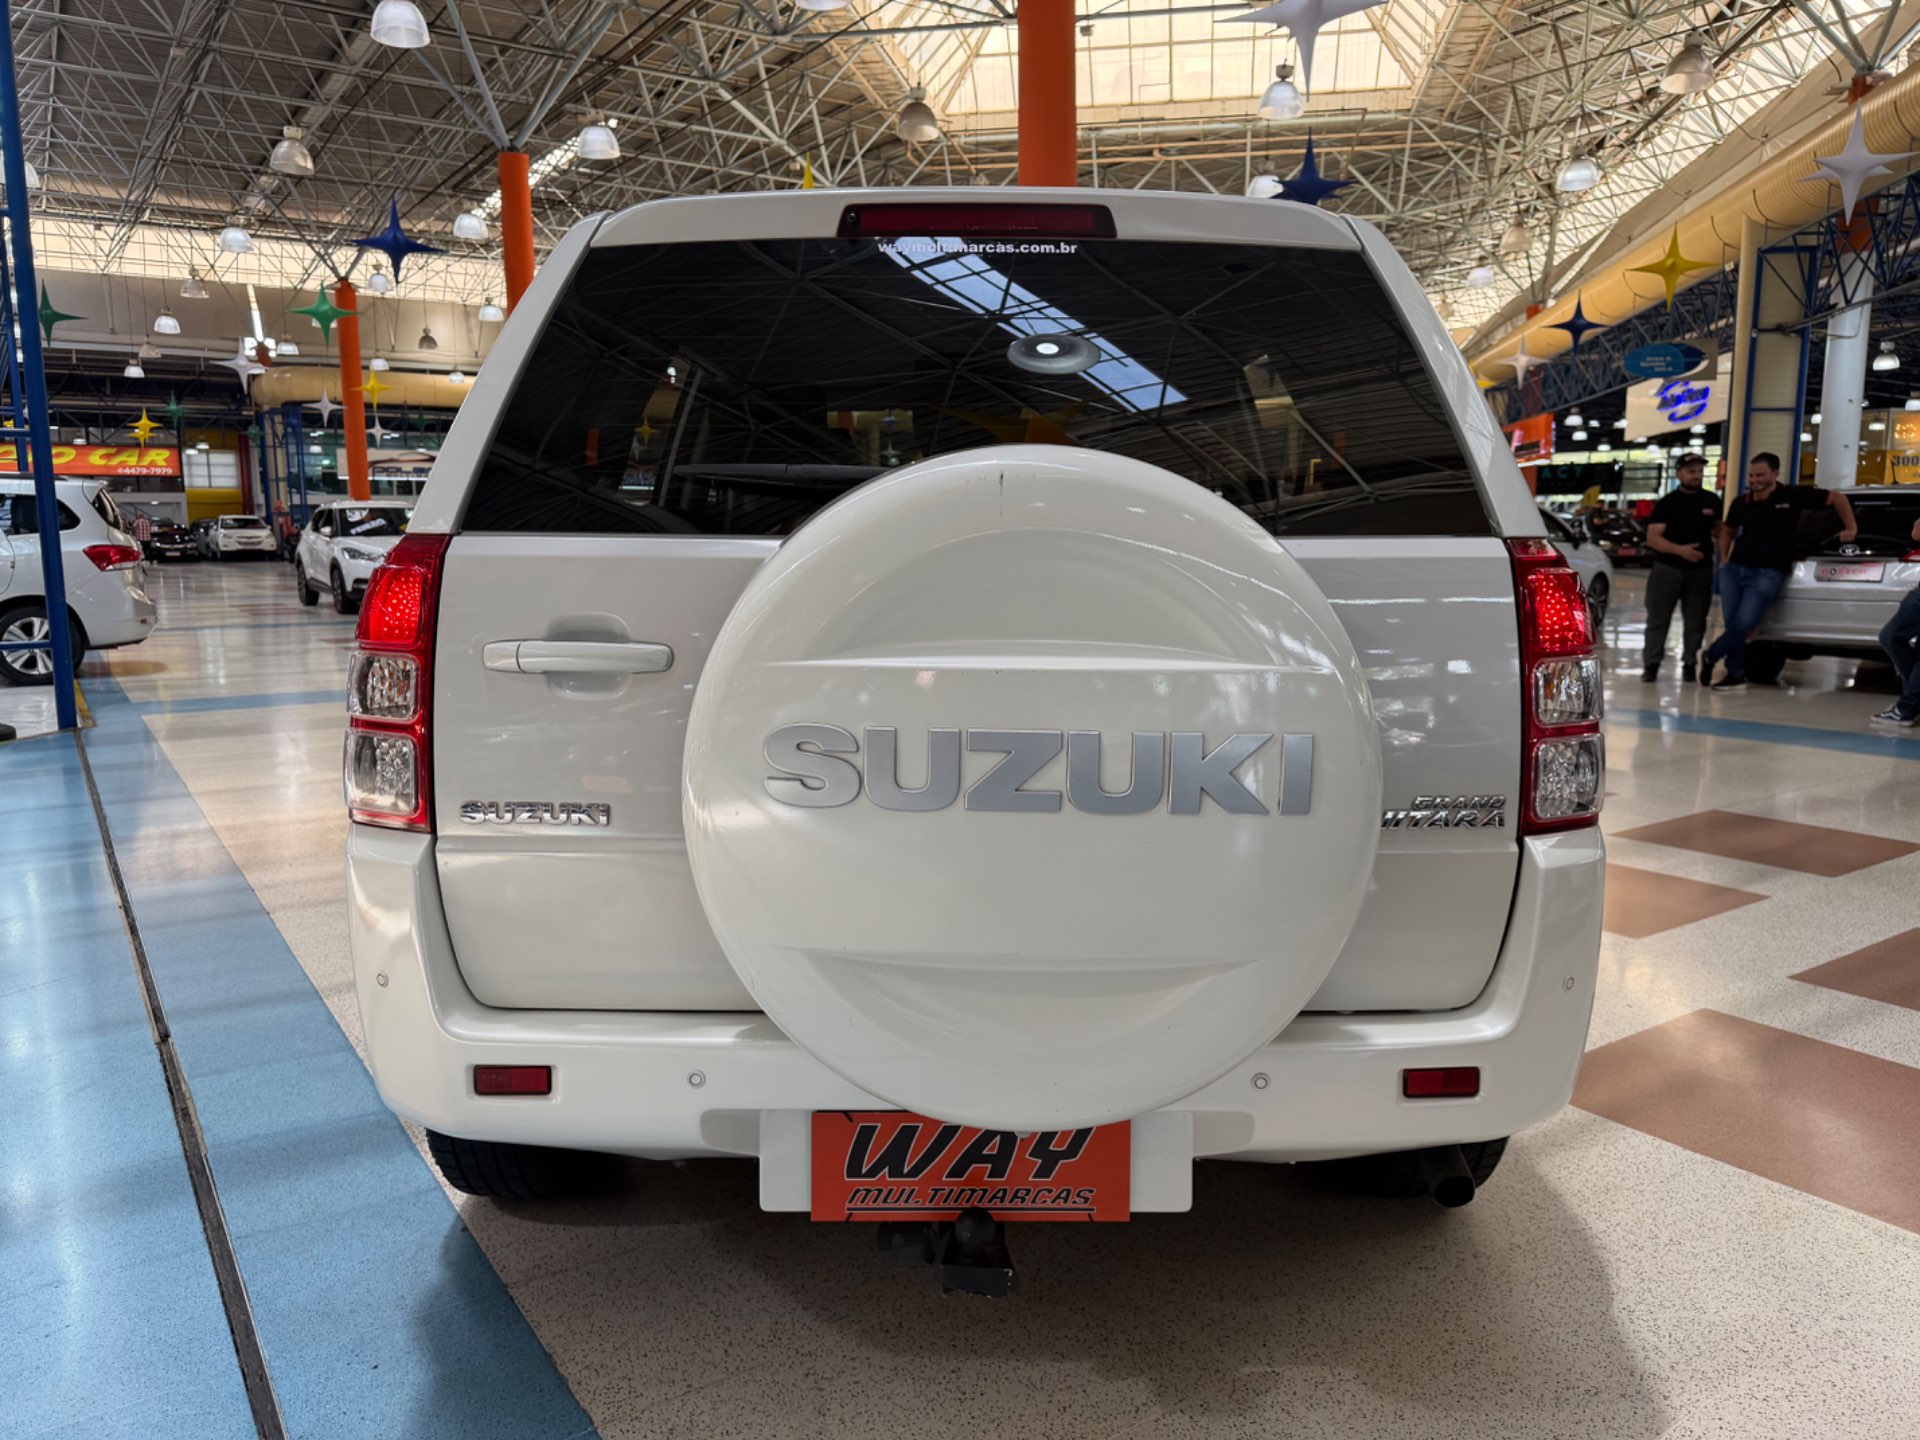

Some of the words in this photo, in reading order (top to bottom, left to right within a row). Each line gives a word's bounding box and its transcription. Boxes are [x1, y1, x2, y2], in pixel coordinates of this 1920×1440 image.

[88, 447, 171, 466] CAR
[764, 722, 1313, 815] SUZUKI
[460, 801, 610, 826] SUZUKI
[1413, 796, 1505, 809] GRAND
[844, 1122, 1096, 1180] WAY
[846, 1186, 1096, 1205] MULTIMARCAS
